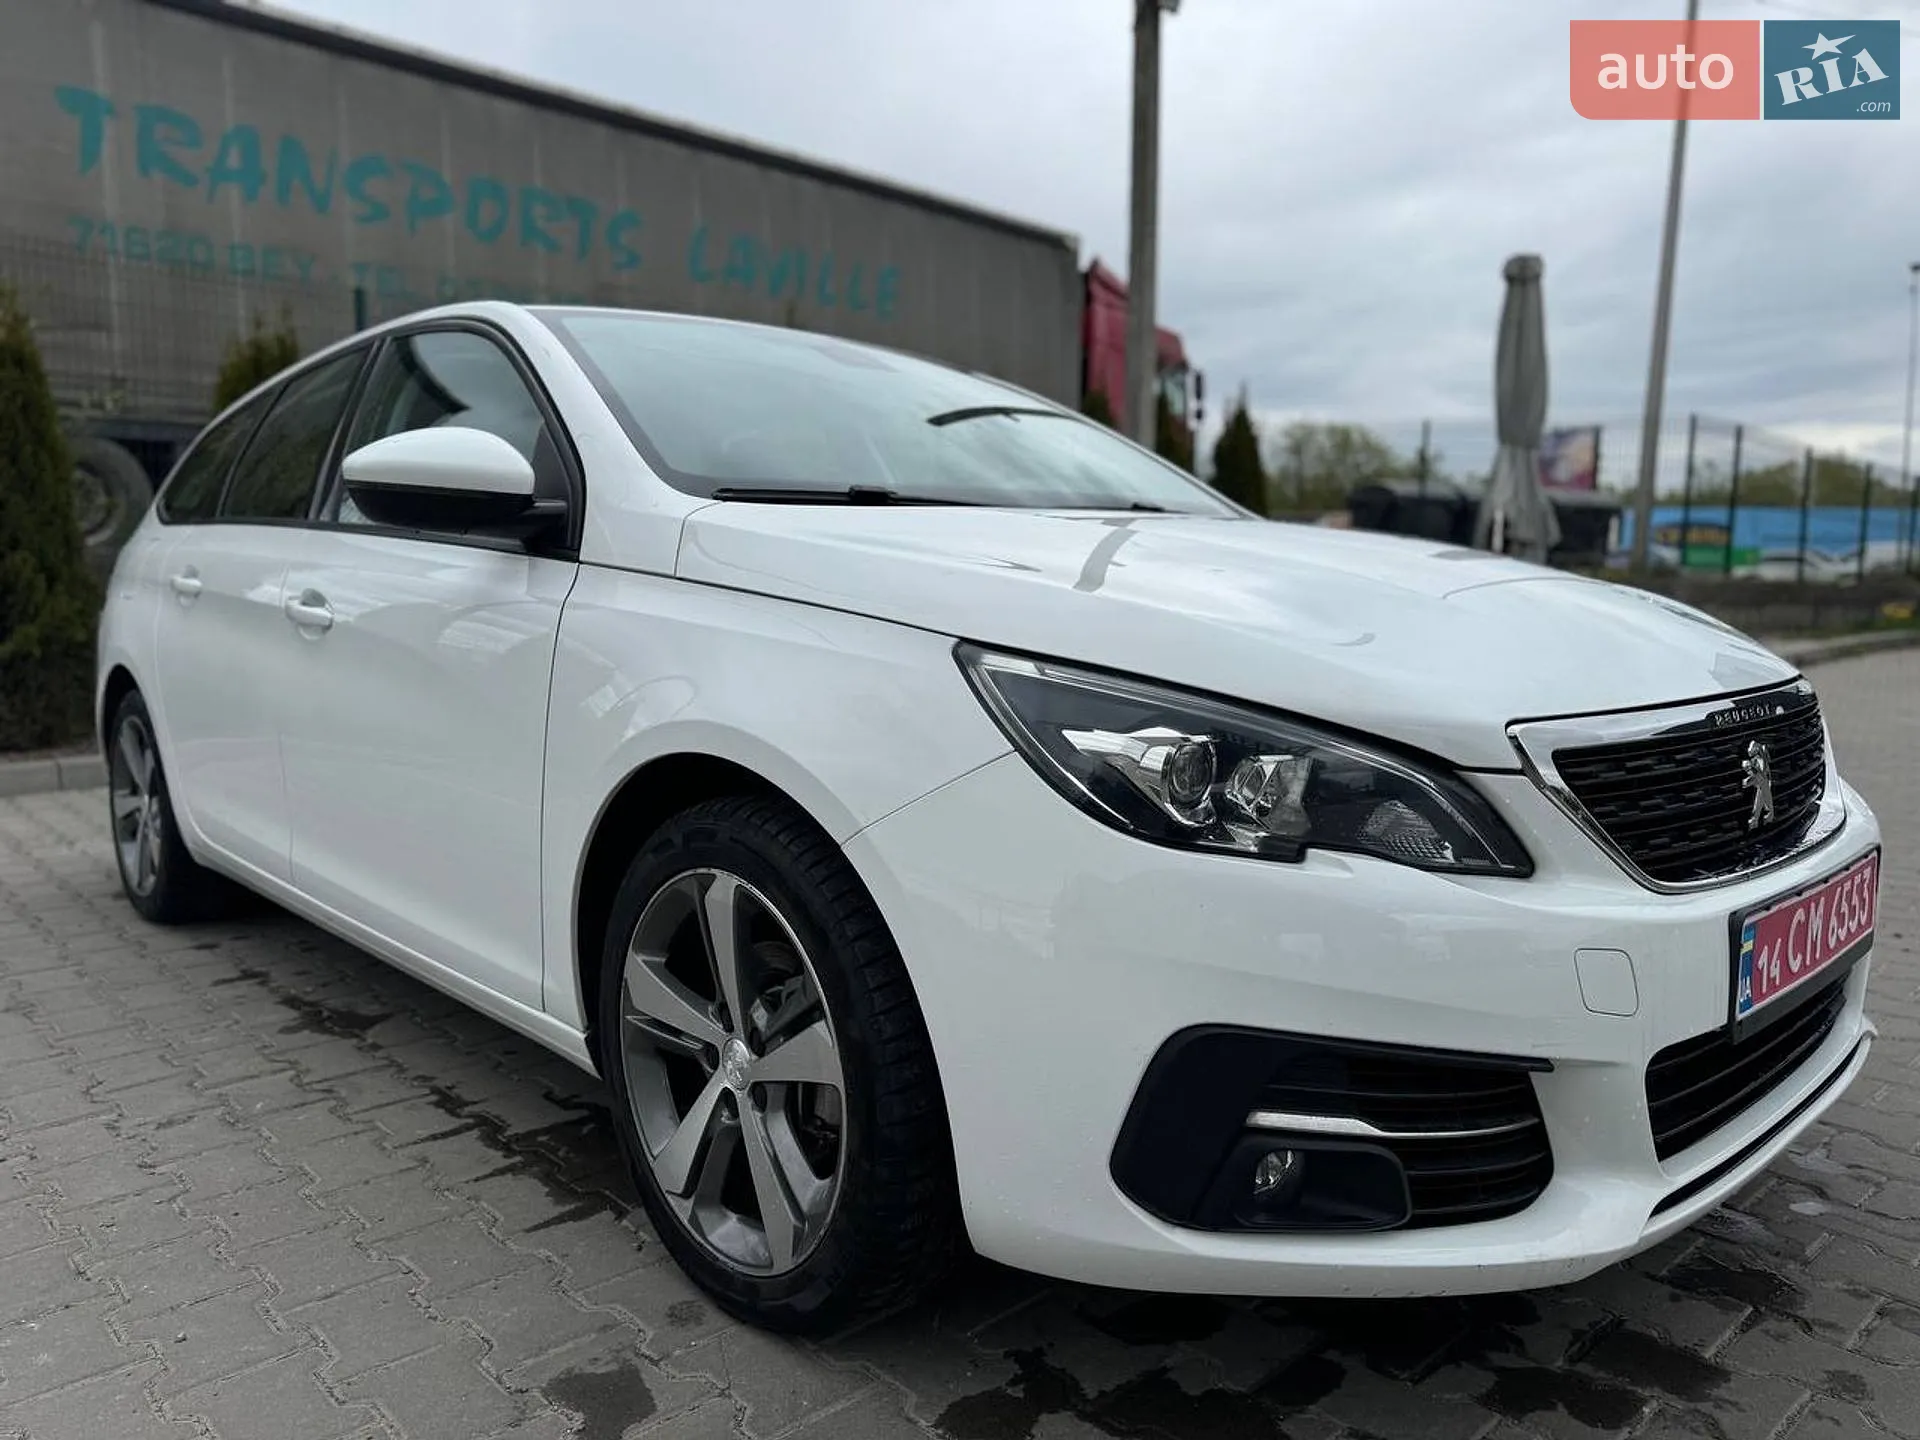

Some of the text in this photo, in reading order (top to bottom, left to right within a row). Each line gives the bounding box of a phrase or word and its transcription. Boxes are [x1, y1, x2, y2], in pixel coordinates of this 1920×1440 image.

[54, 84, 900, 324] TRANSPORTS LAVILLE
[1758, 867, 1872, 993] 14 CM 6553
